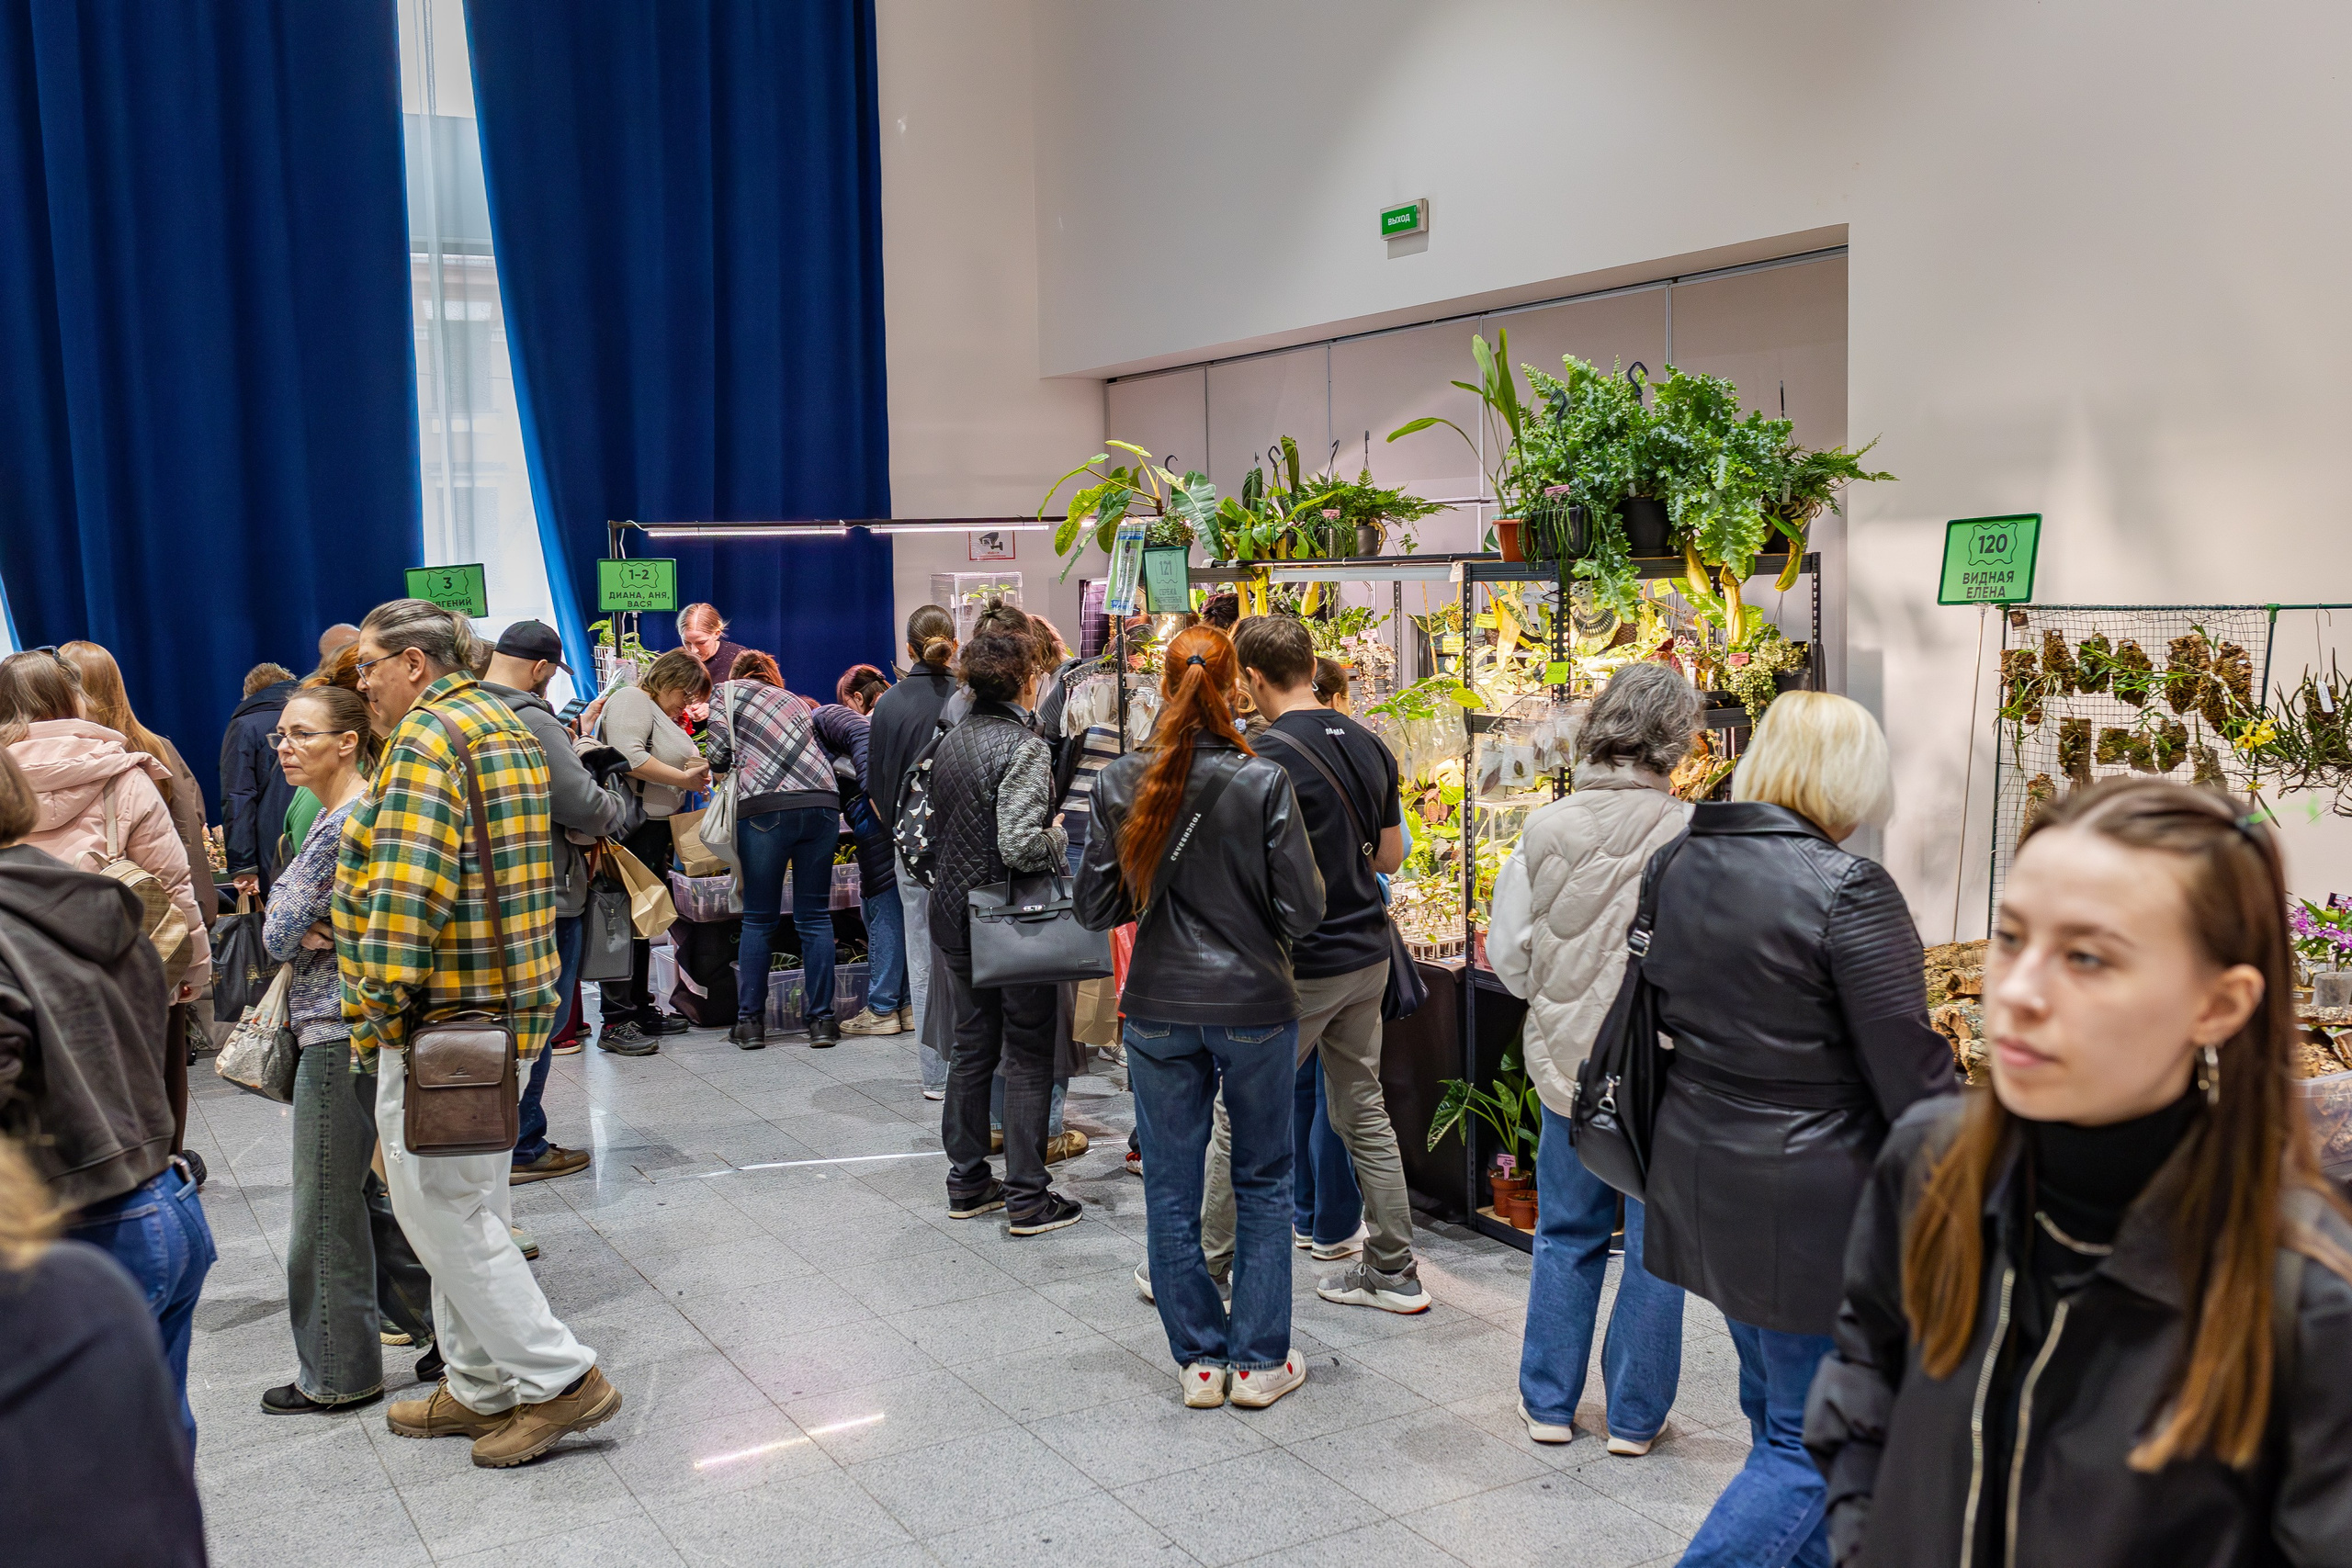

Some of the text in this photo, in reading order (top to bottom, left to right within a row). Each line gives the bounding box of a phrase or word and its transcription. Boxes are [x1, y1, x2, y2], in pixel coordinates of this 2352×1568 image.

[1387, 213, 1410, 226] ВЫХОД
[1978, 534, 2007, 554] 120
[1159, 559, 1172, 576] 121
[628, 570, 650, 580] 1-2
[1962, 570, 2015, 585] ВИДНАЯ
[443, 577, 453, 589] 3
[608, 592, 670, 600] ДИАНА, АНЯ,
[1966, 586, 2006, 599] ЕЛЕНА
[627, 600, 652, 608] ВАСЯ
[1170, 813, 1202, 861] TOUCHBRAND
